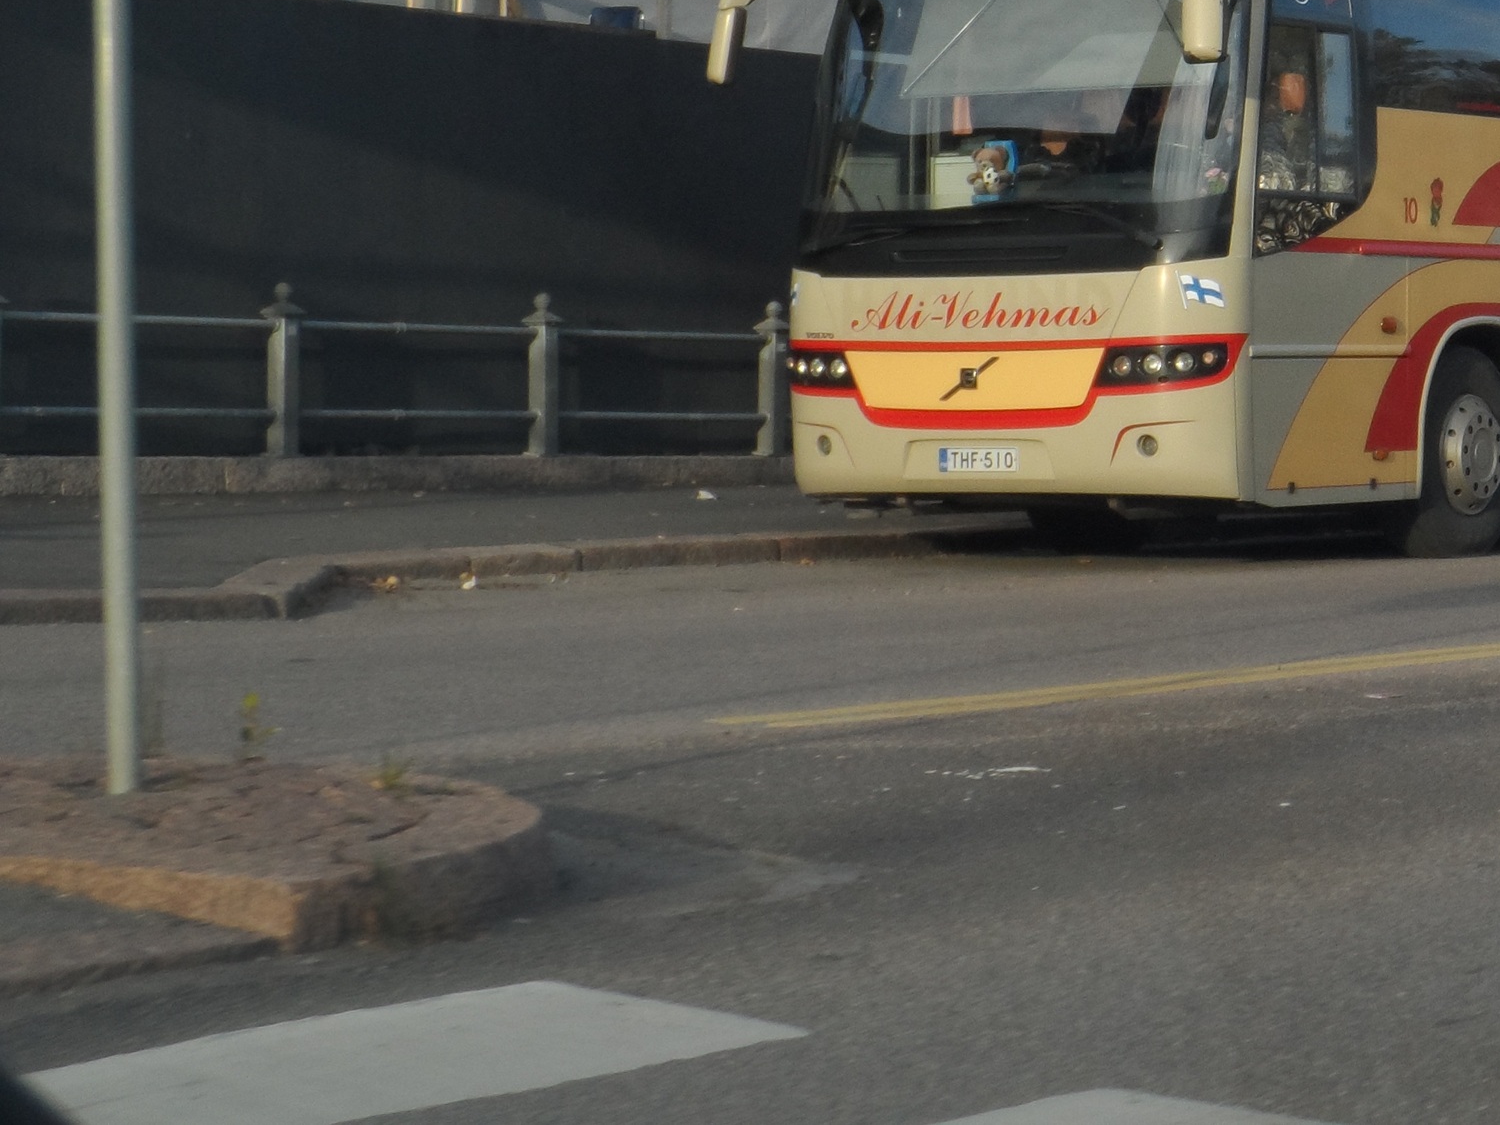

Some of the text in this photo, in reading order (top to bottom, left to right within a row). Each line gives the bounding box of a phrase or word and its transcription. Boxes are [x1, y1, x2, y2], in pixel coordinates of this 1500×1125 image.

[1403, 197, 1418, 224] 10
[851, 290, 1110, 332] Ali-Vehmas
[950, 451, 1014, 469] THF-510
